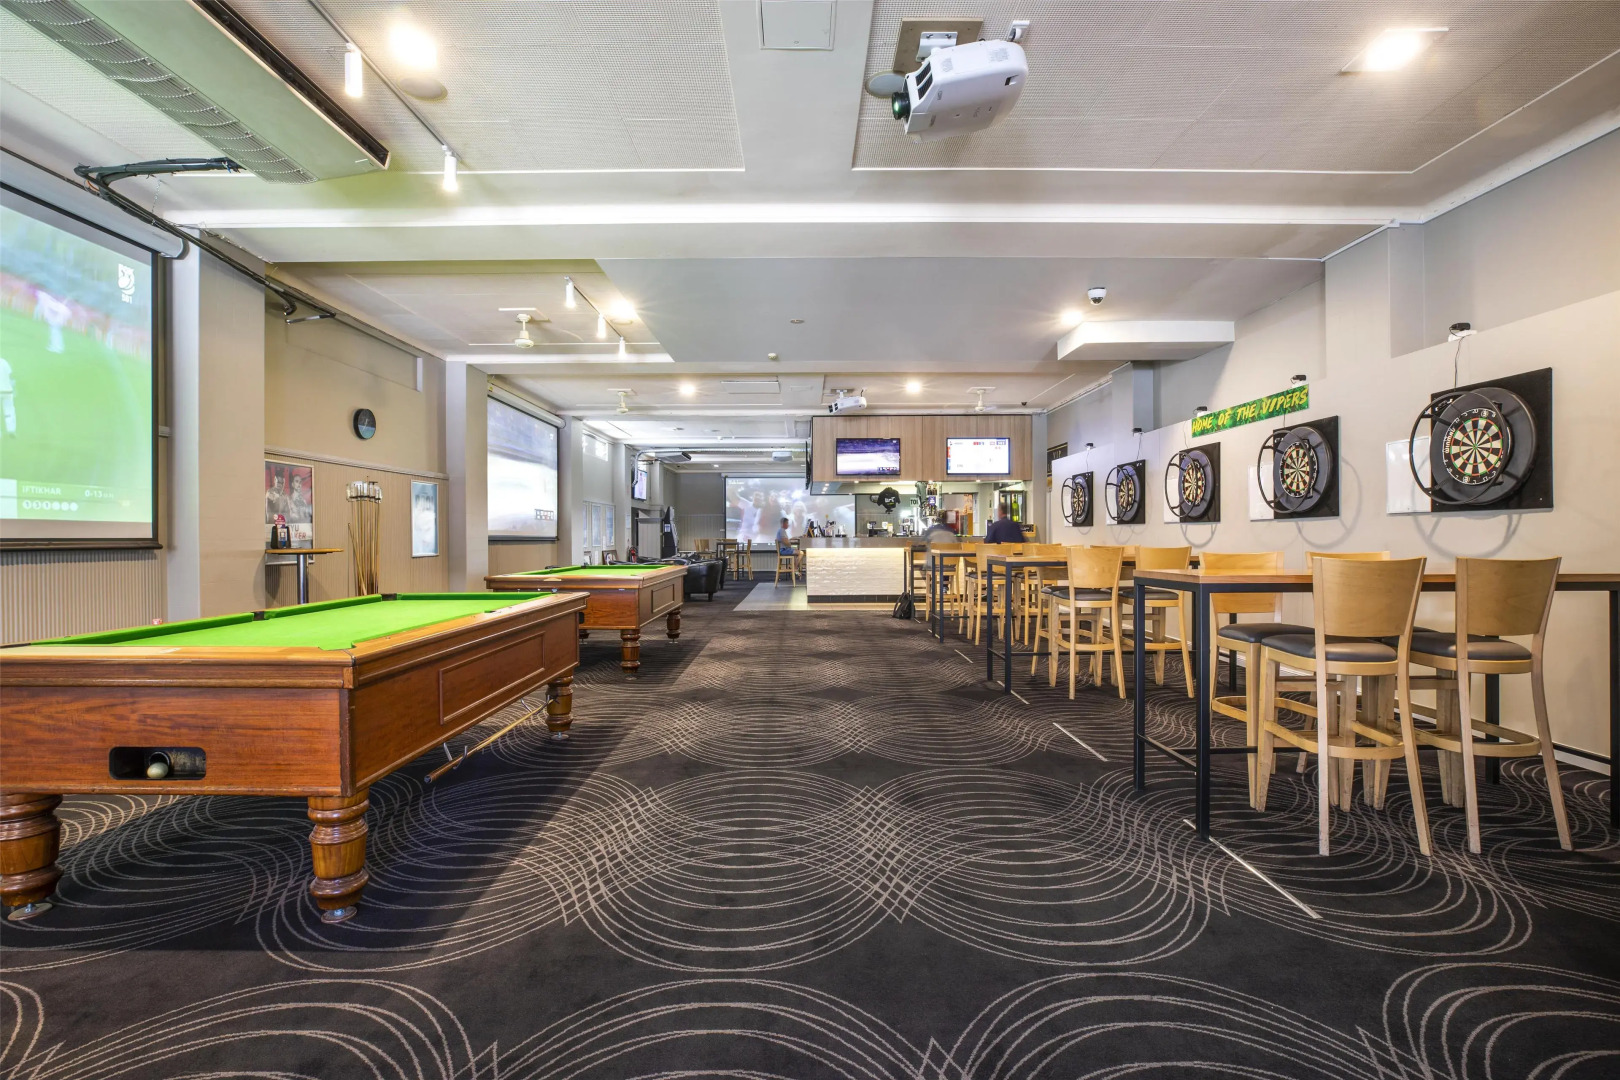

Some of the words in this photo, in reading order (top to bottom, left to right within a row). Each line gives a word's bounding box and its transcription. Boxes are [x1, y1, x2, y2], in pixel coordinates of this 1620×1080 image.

[1191, 416, 1214, 433] HOME
[1218, 411, 1231, 426] OF
[1236, 403, 1258, 421] THE
[1262, 388, 1309, 415] VIPERS
[22, 485, 62, 496] IFTIKHAR
